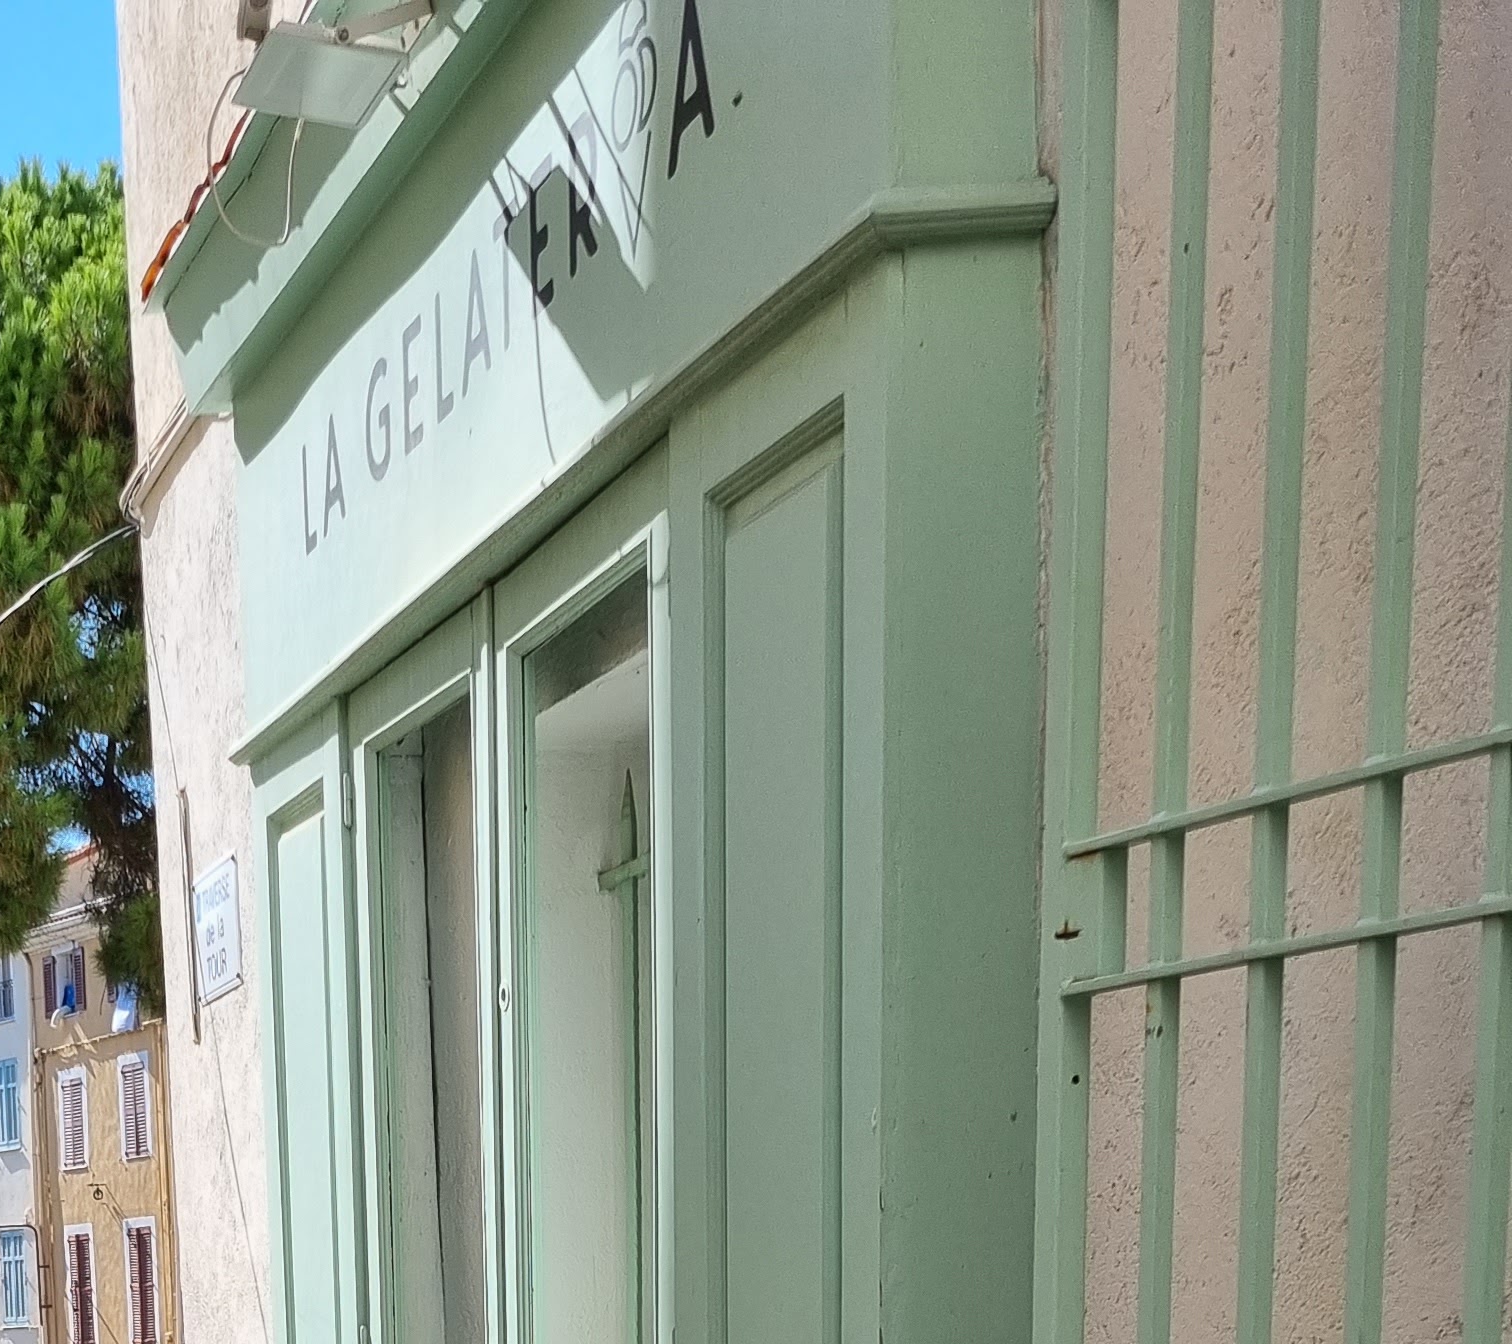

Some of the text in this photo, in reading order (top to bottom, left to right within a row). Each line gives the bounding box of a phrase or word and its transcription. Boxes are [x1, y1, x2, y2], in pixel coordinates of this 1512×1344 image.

[301, 412, 347, 558] LA
[206, 914, 225, 947] de la
[206, 947, 228, 984] TOUR
